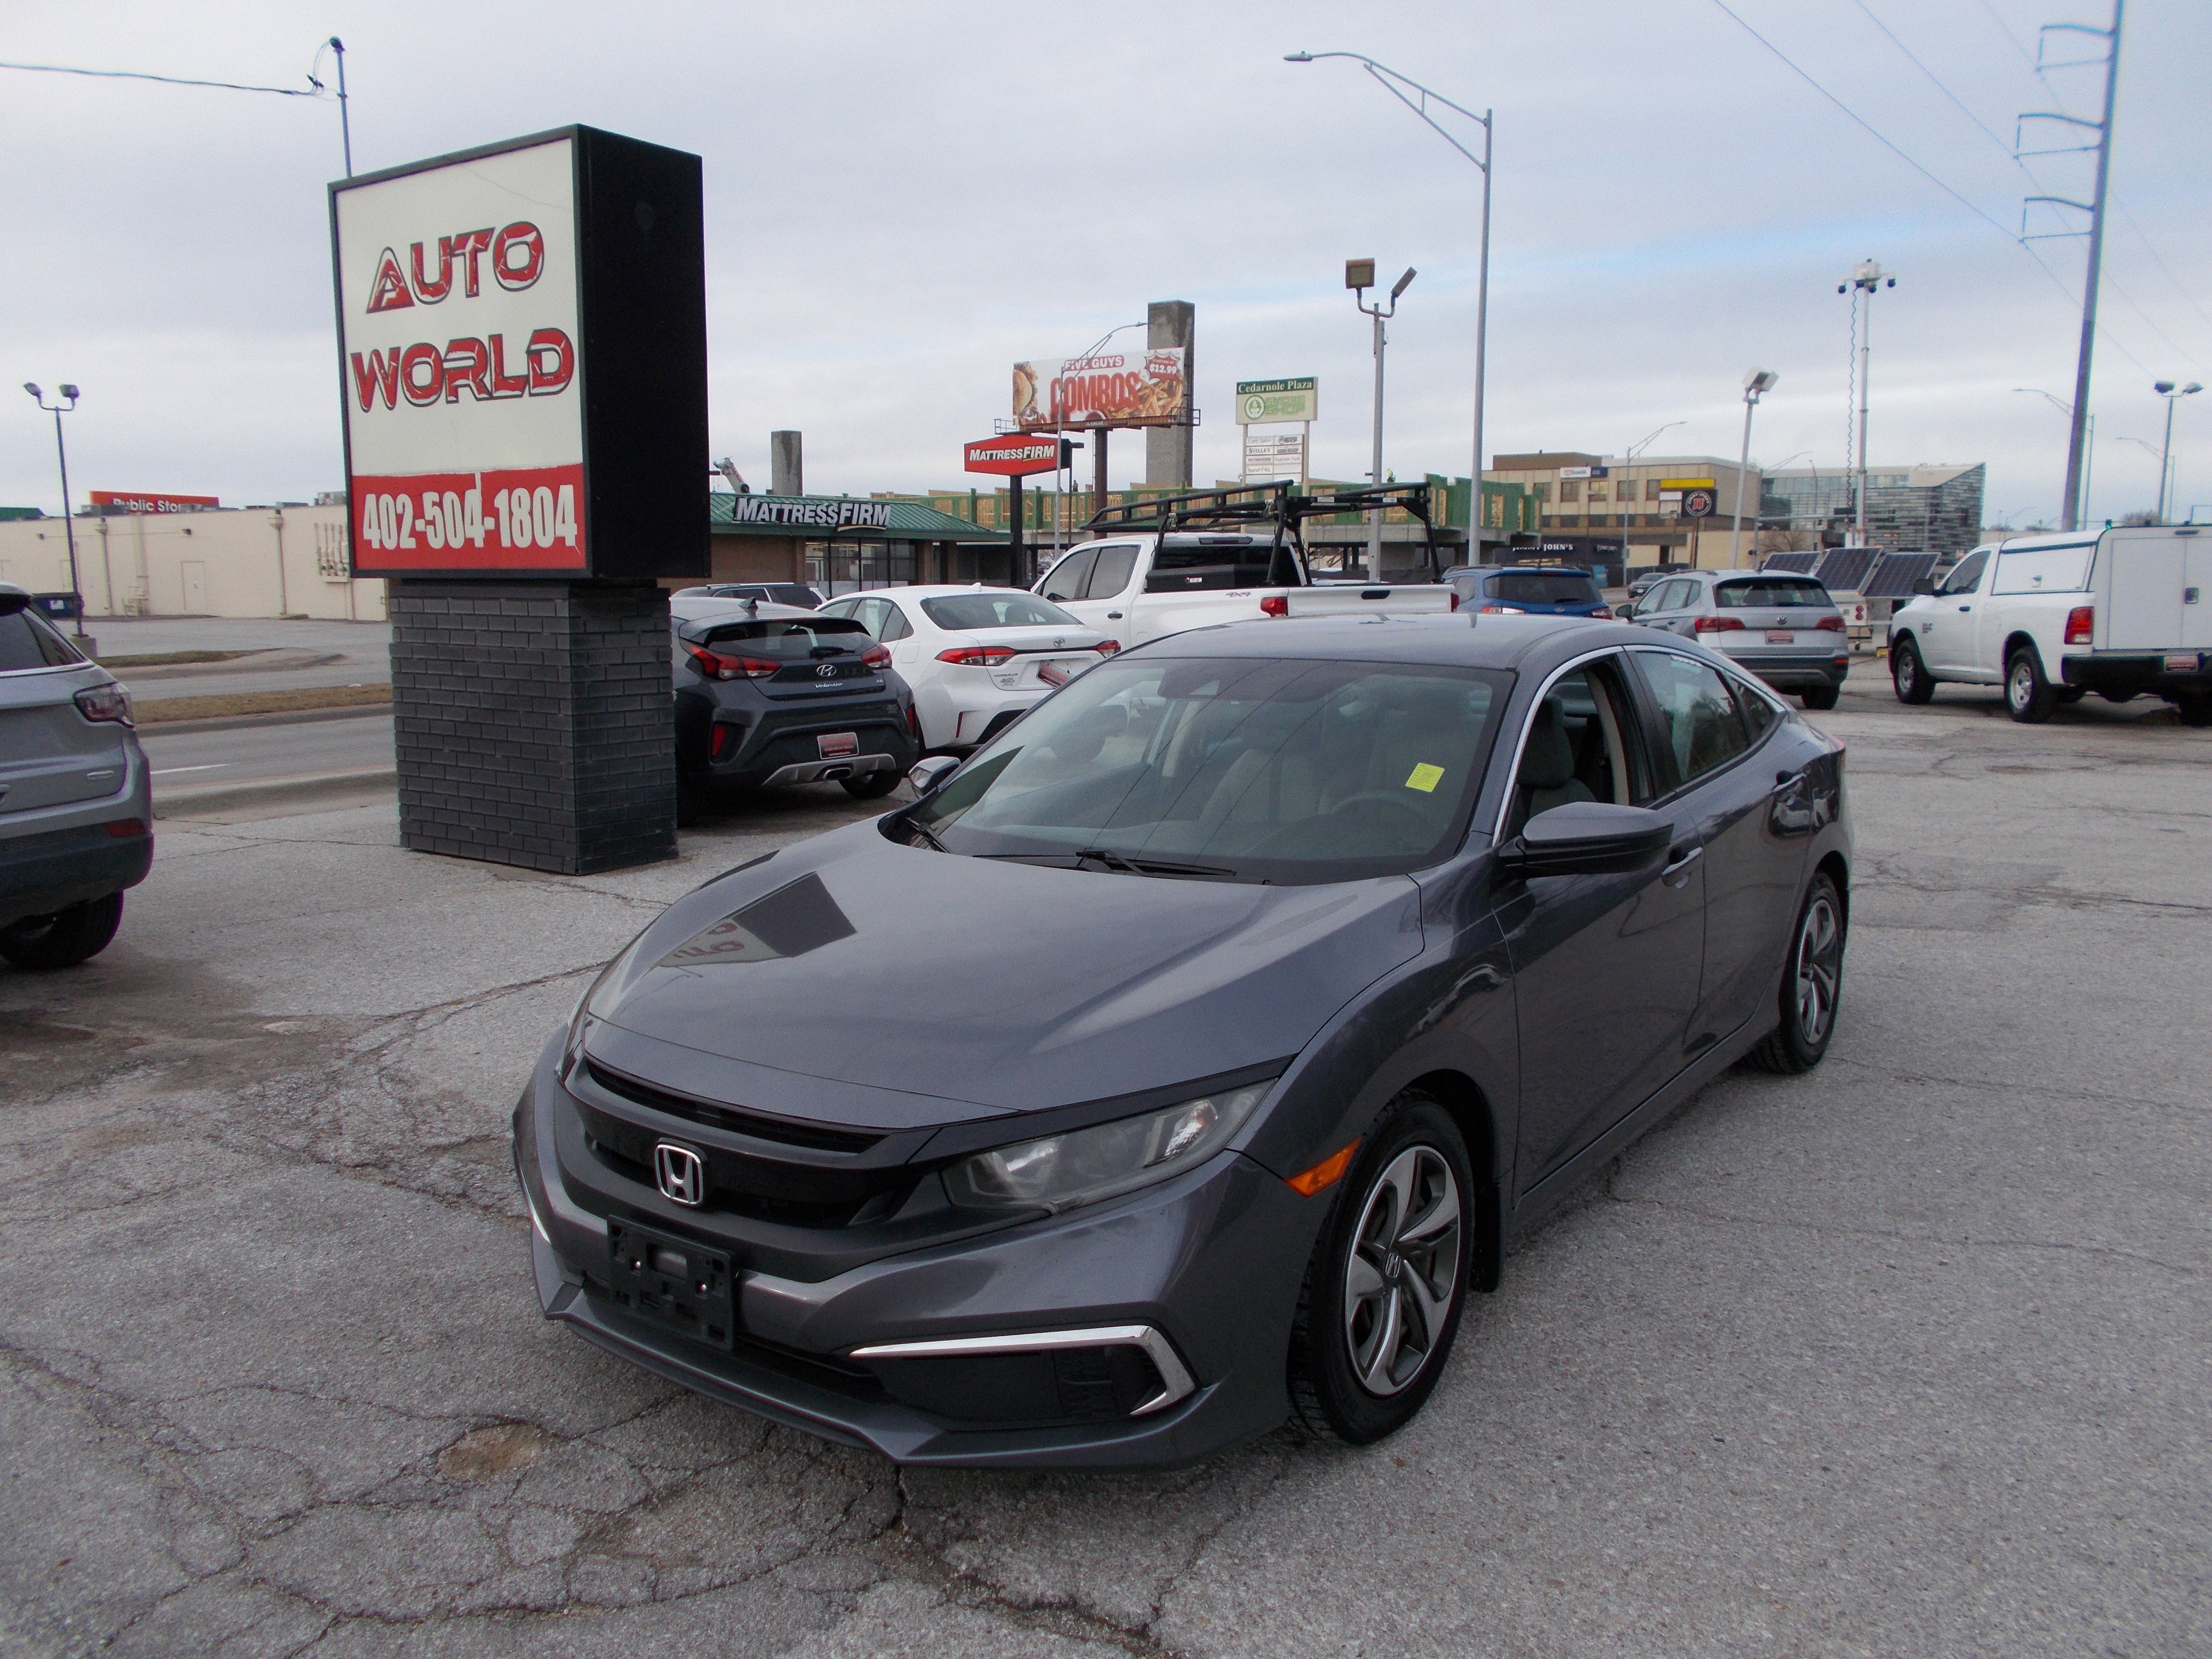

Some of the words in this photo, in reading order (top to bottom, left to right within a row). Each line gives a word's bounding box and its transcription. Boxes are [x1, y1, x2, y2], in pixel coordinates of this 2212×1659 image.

[366, 221, 544, 314] AUTO
[350, 327, 575, 413] WORLD
[1065, 359, 1089, 370] FIVE
[1092, 356, 1123, 368] GUYS
[1149, 363, 1177, 374] $12.99
[1050, 371, 1141, 418] COMBOS
[1238, 382, 1285, 393] Cedarnole
[1287, 380, 1312, 390] Plaza
[363, 484, 578, 549] 402-504-1804
[1543, 543, 1574, 552] JOHN'S
